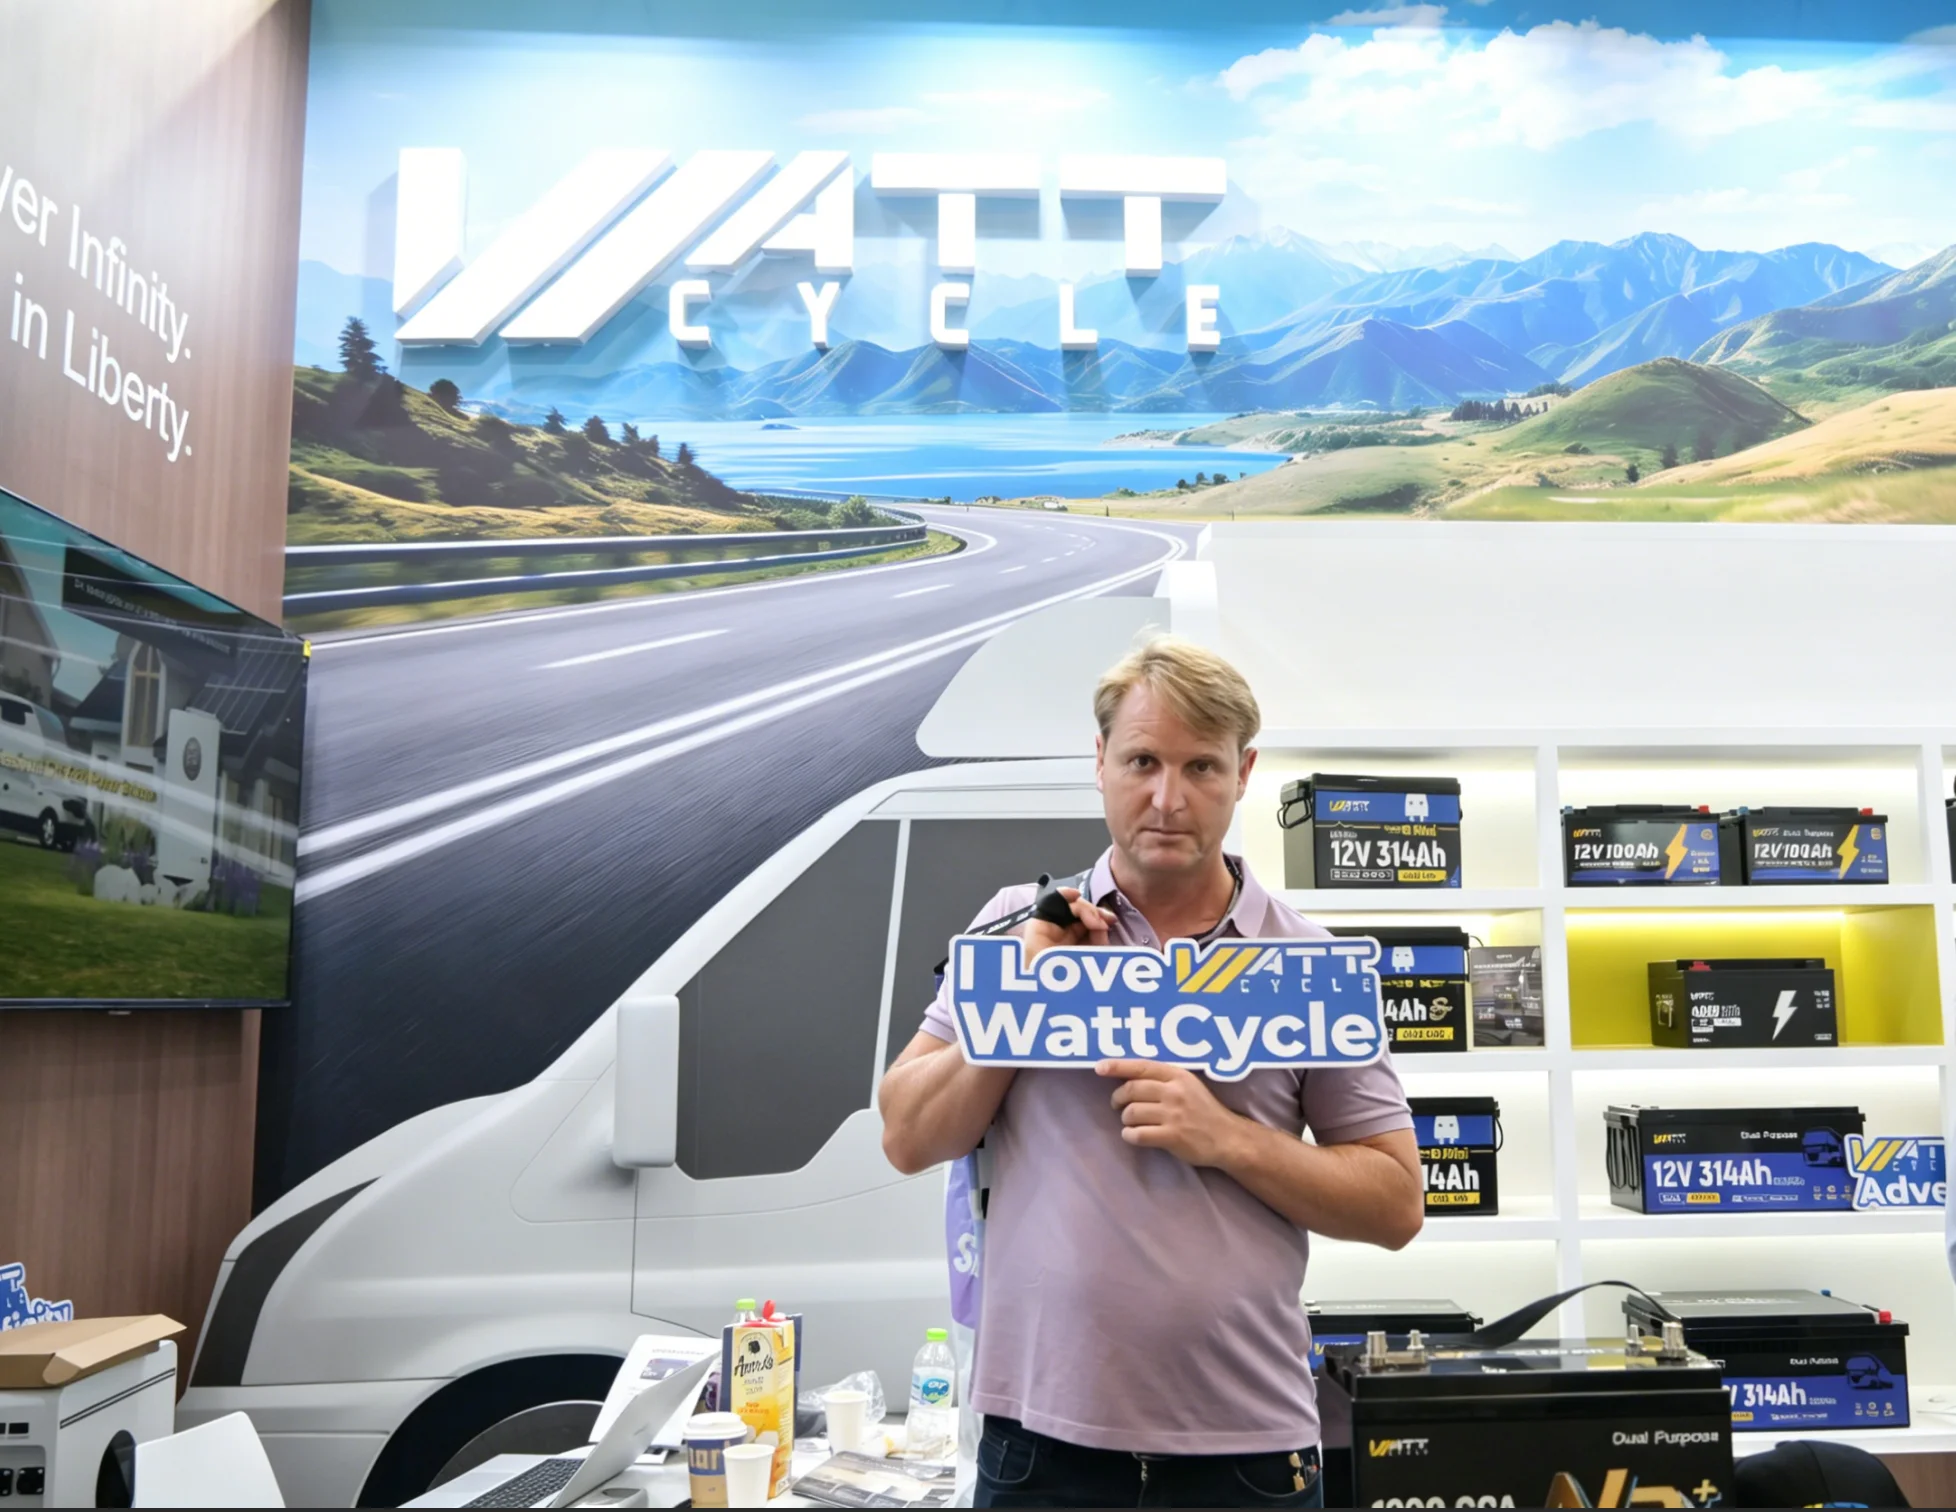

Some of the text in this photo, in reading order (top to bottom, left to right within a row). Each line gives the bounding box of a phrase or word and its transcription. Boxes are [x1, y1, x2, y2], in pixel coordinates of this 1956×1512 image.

[68, 204, 191, 363] Infinity.
[668, 280, 1222, 351] CYCLE
[11, 271, 192, 462] in Liberty.
[1331, 840, 1447, 868] 12V 314Ah
[960, 945, 973, 990] I
[1001, 944, 1164, 993] Love
[1240, 977, 1372, 994] CYCLE
[959, 1000, 1378, 1072] WattCycle
[1652, 1158, 1772, 1187] 12V 314Ah
[1743, 1382, 1807, 1406] 314Ah
[1612, 1431, 1649, 1445] Dual
